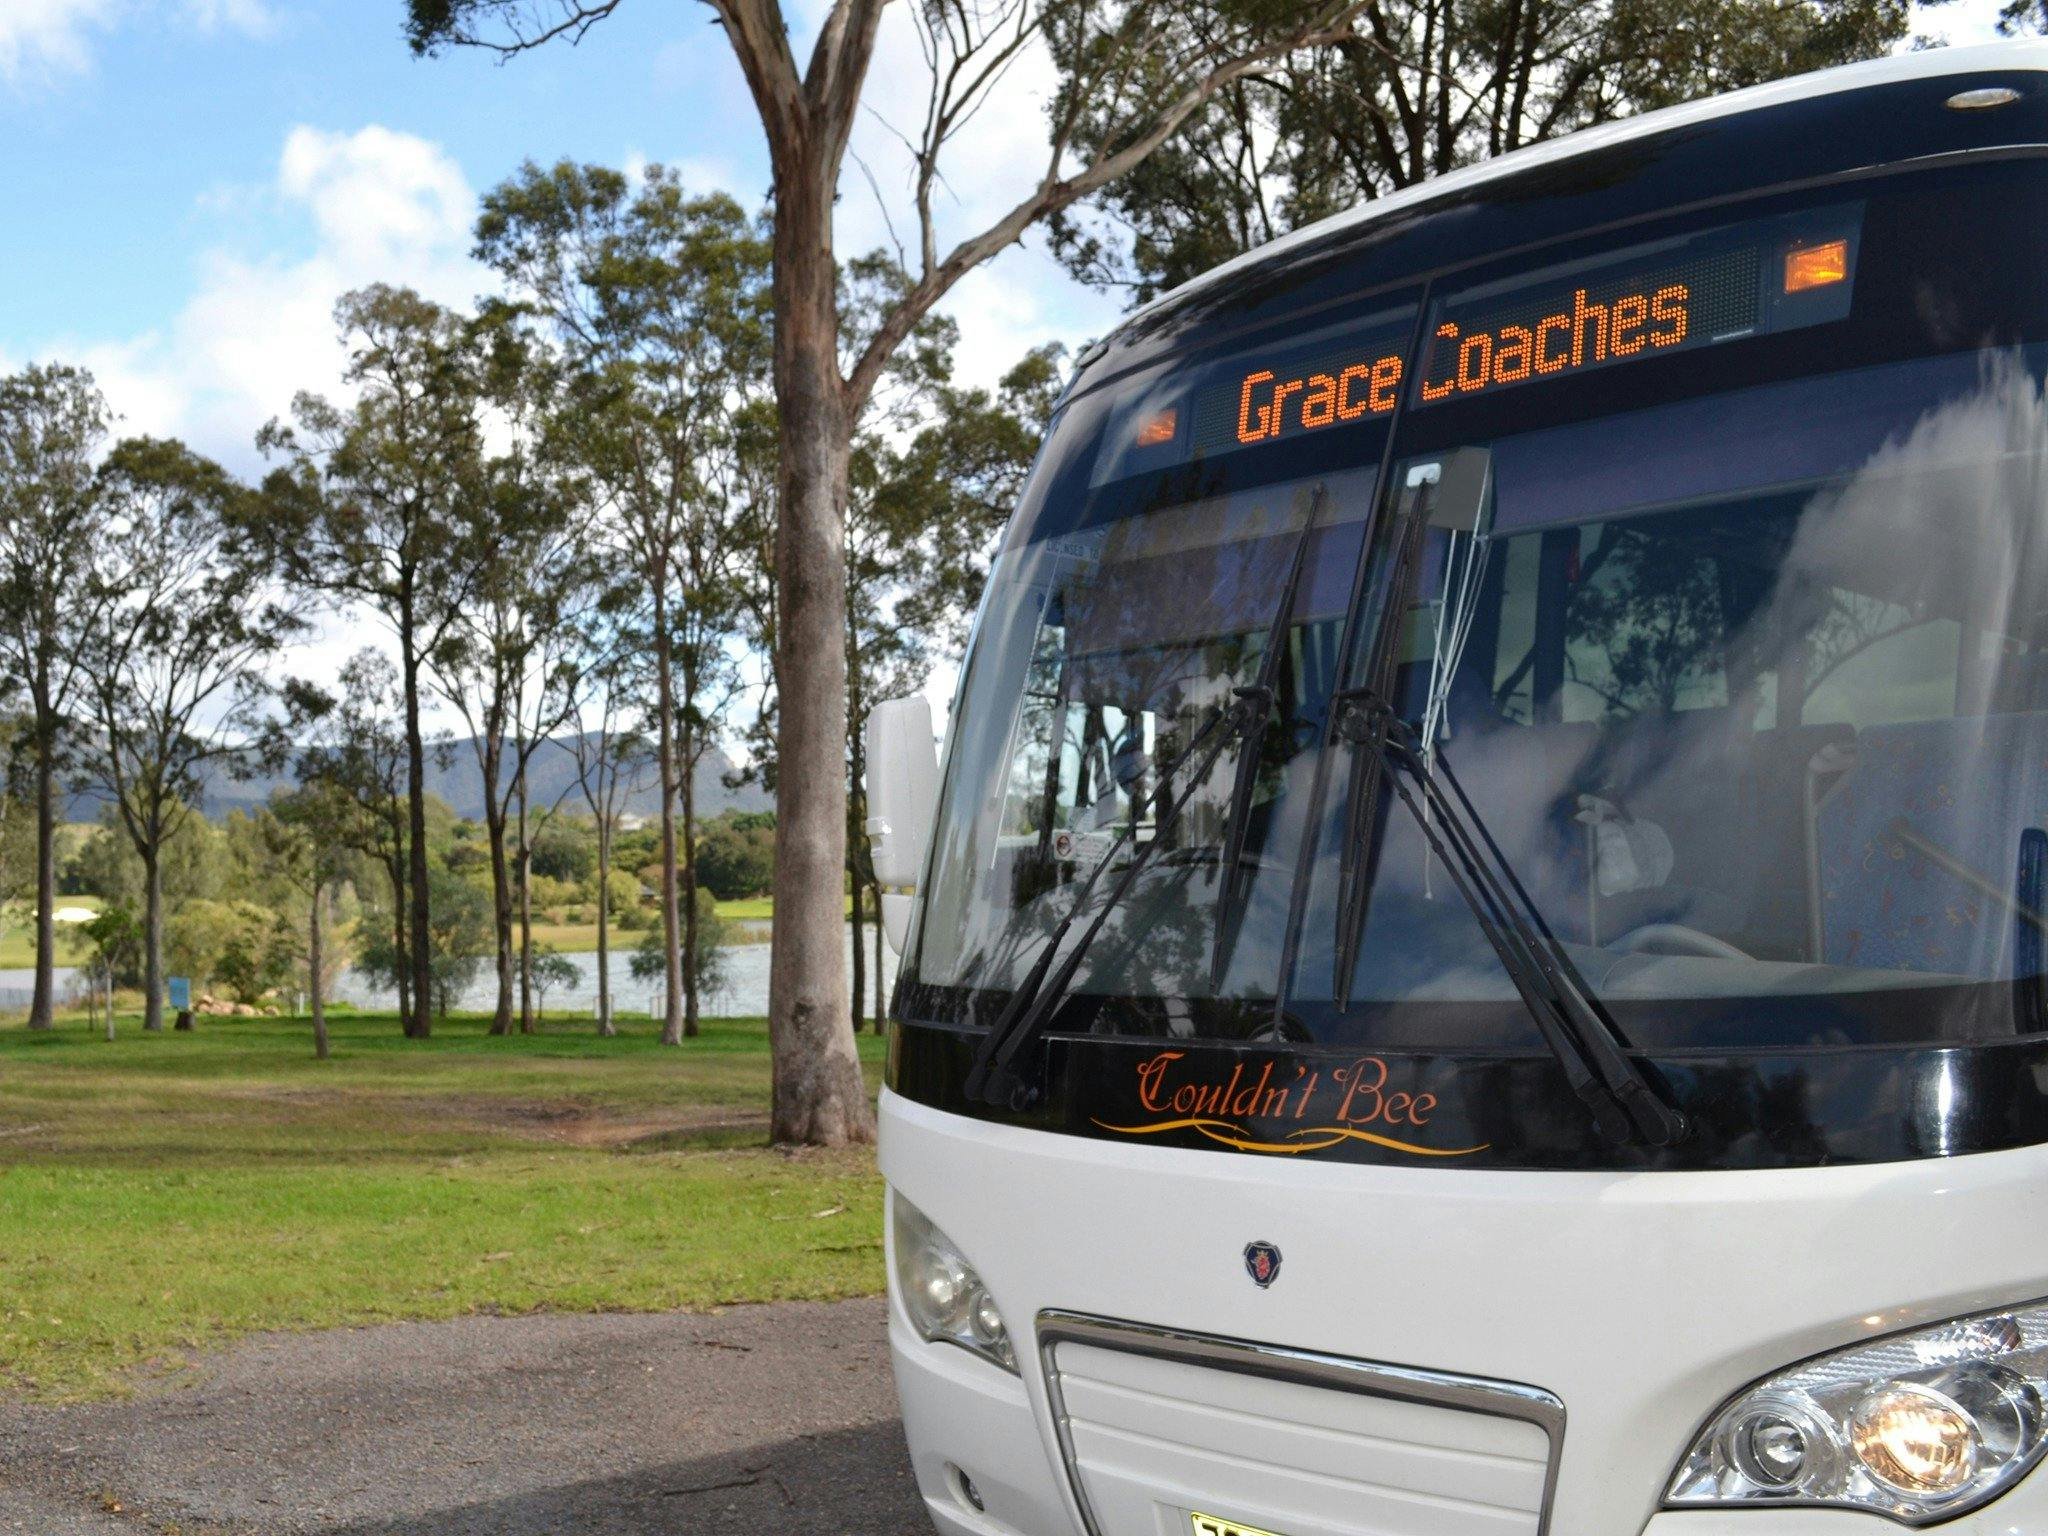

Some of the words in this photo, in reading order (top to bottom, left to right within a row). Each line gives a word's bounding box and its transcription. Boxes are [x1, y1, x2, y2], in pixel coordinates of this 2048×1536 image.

[1237, 356, 1402, 443] Grace
[1422, 284, 1688, 401] Coaches
[1137, 1052, 1318, 1118] Couldn't
[1333, 1057, 1437, 1125] Bee
